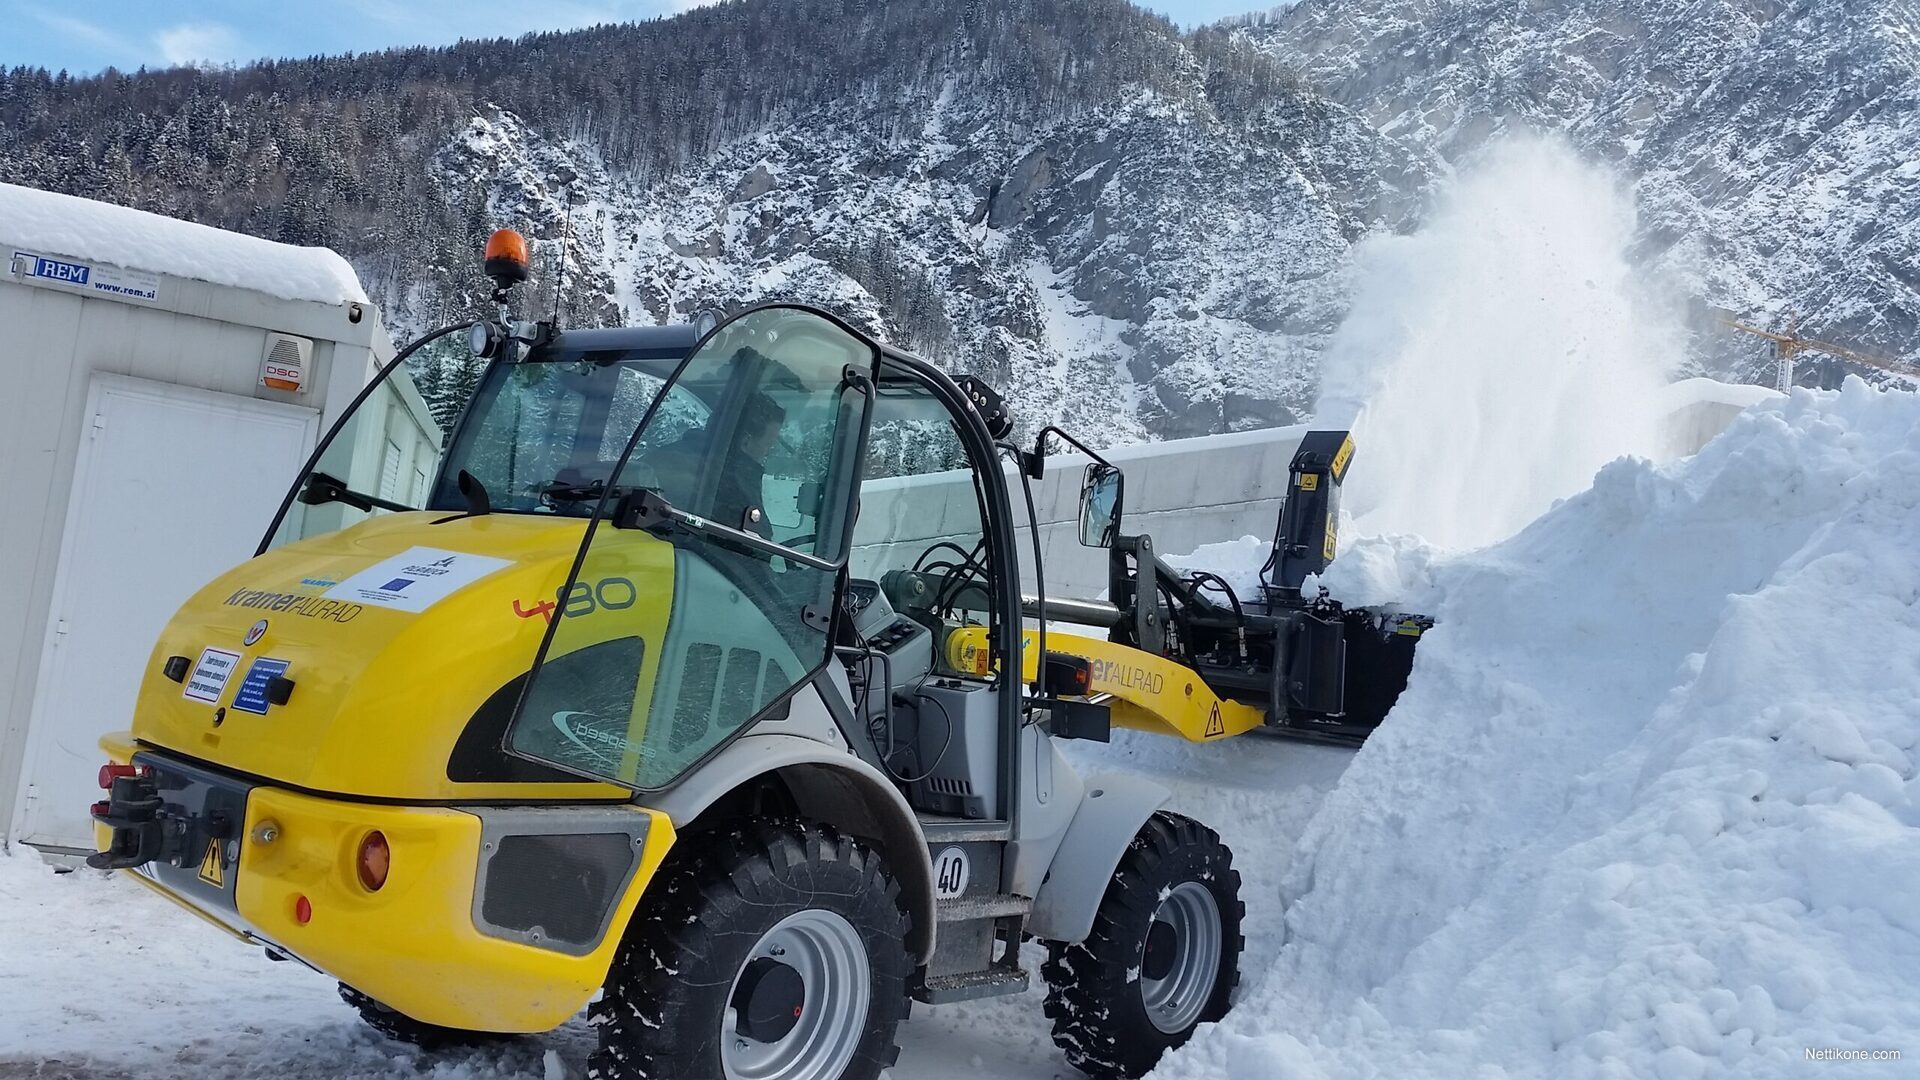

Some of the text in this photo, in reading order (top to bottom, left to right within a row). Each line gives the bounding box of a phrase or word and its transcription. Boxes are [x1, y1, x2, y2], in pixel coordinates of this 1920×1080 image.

[43, 261, 86, 282] REM
[95, 281, 156, 299] www.rem.si
[267, 366, 299, 378] DSC
[223, 587, 363, 623] kramerALLRAD
[513, 577, 637, 625] 480
[938, 857, 962, 893] 40
